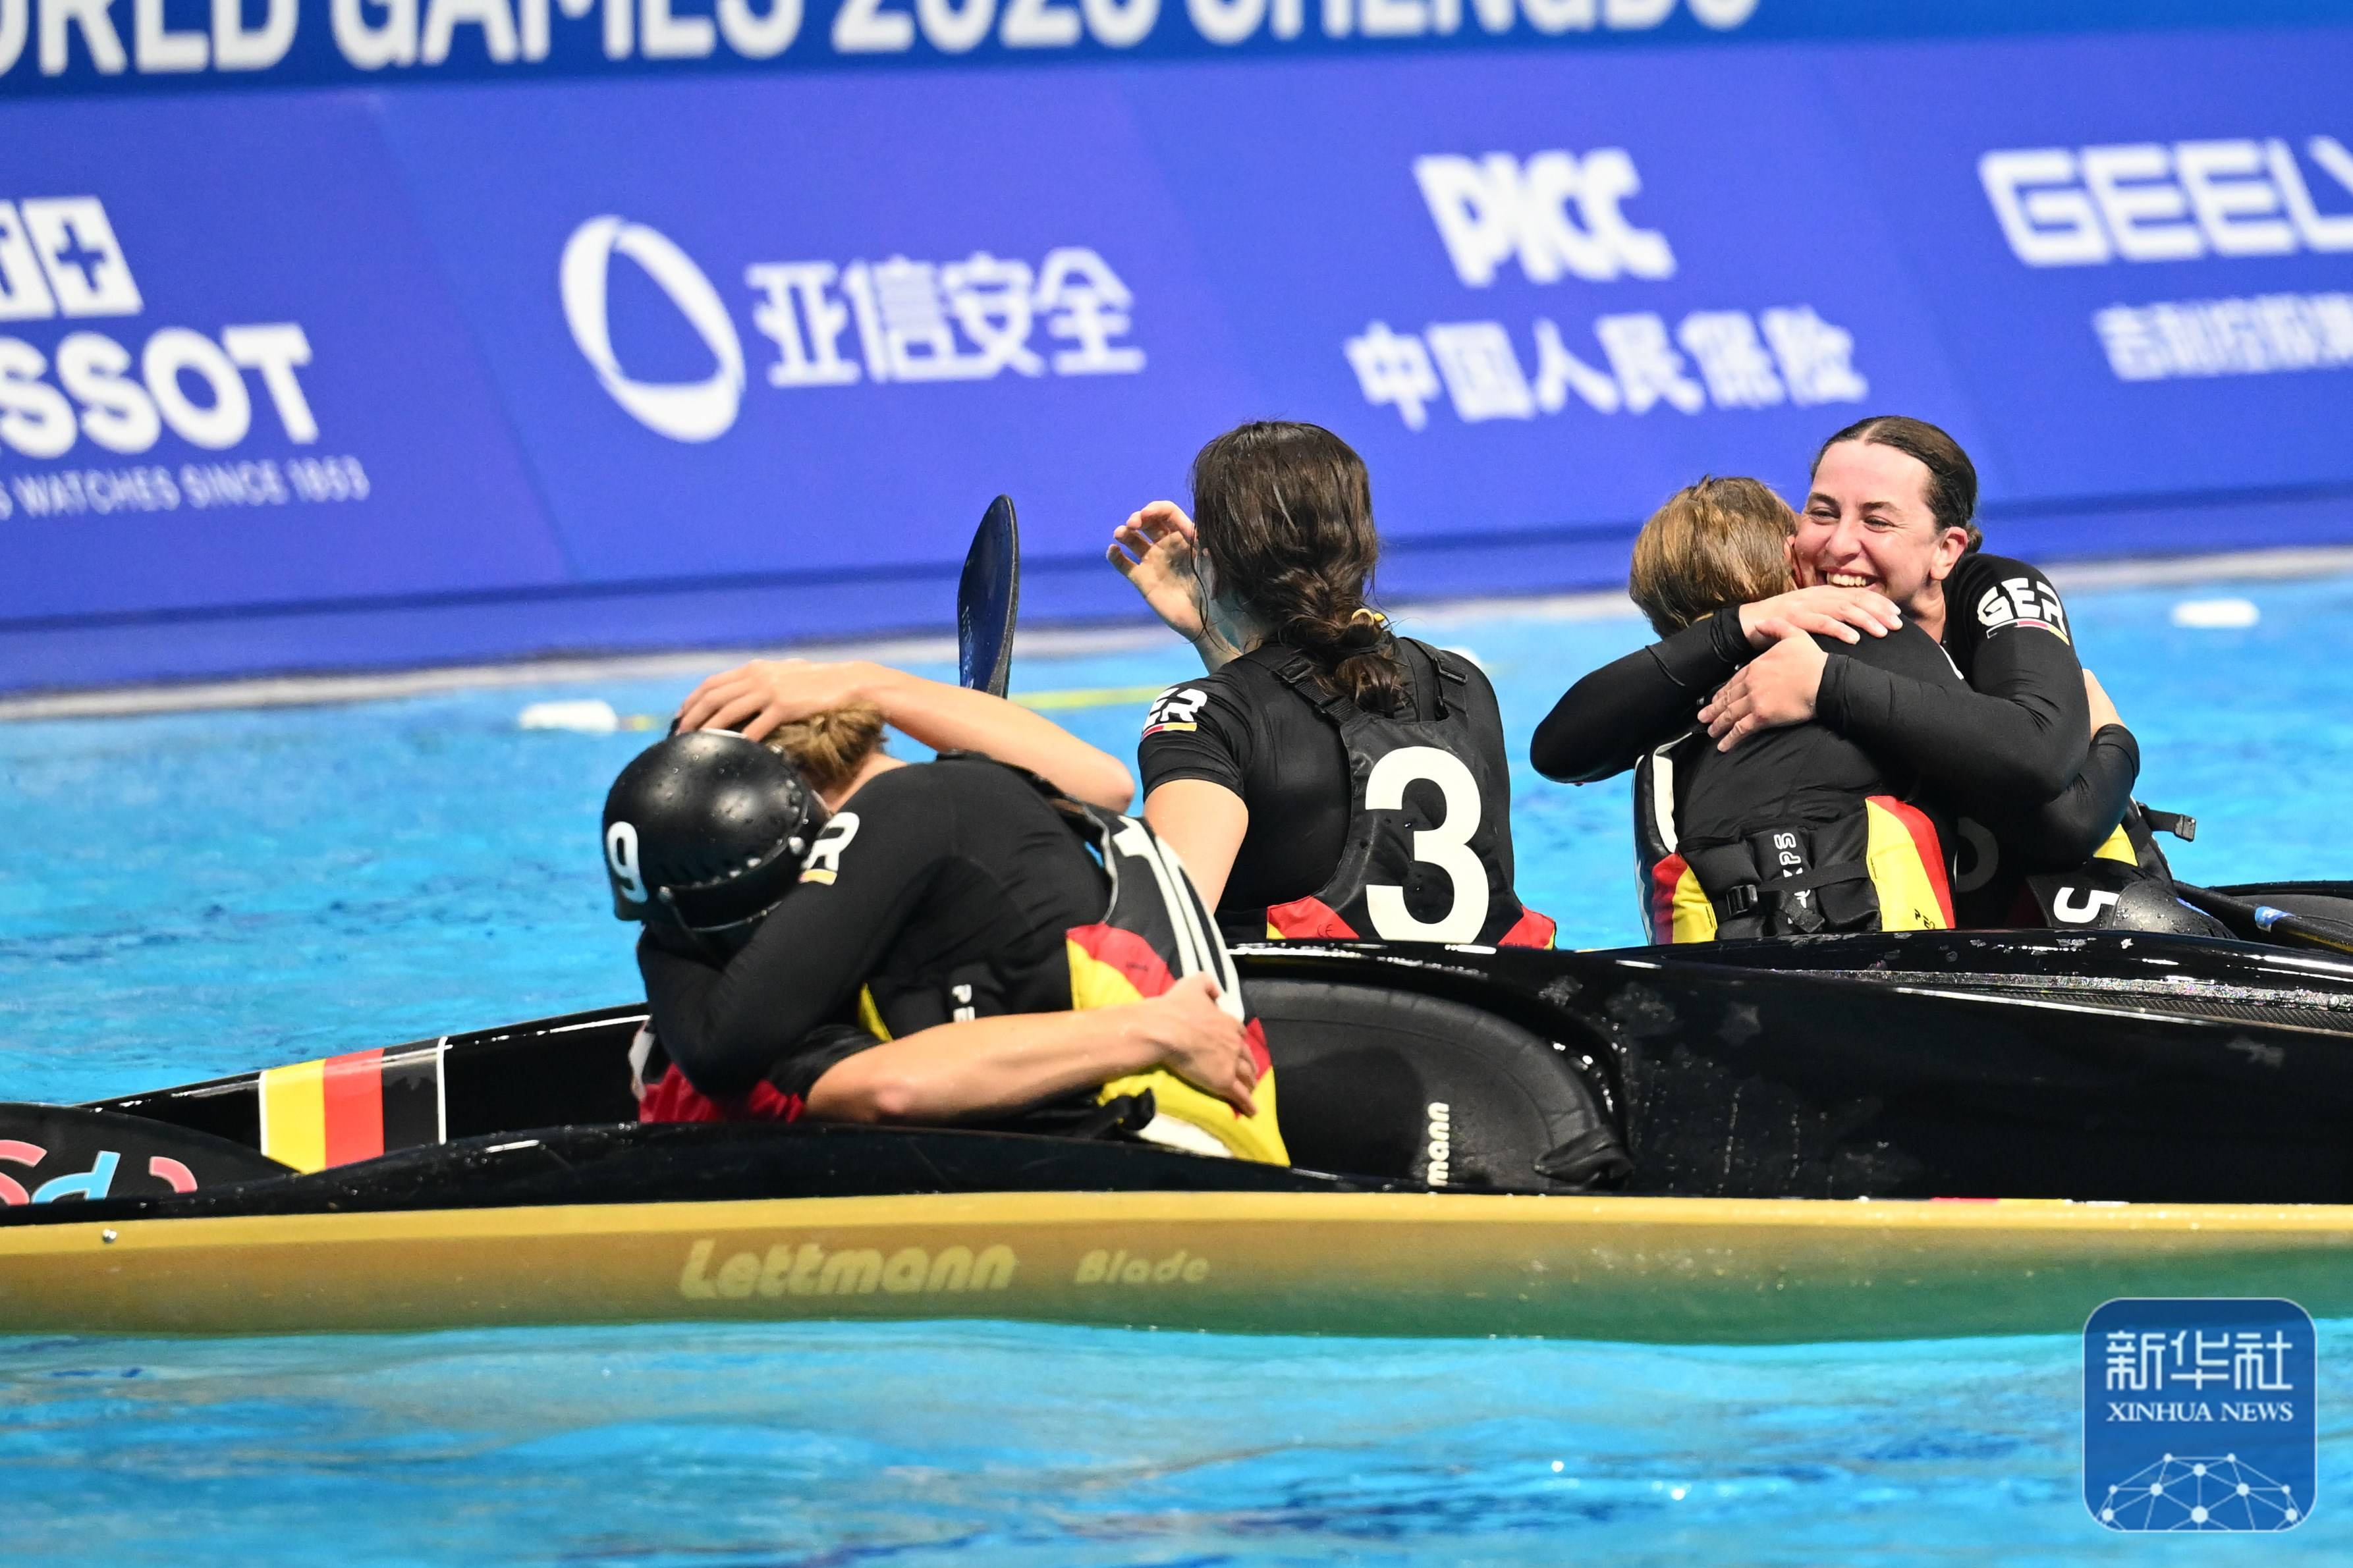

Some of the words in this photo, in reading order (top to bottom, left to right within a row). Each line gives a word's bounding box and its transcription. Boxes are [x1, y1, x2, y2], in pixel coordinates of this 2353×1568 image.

[1412, 146, 1678, 288] PICC
[744, 246, 1146, 387] 亚信安全
[1343, 306, 1871, 433] 中国人民保险
[179, 460, 289, 509] SINCE
[1977, 578, 2068, 636] GER
[605, 821, 649, 904] 9
[1366, 745, 1490, 944] 3
[678, 1237, 1016, 1300] Lettmann
[1075, 1248, 1211, 1285] Blade
